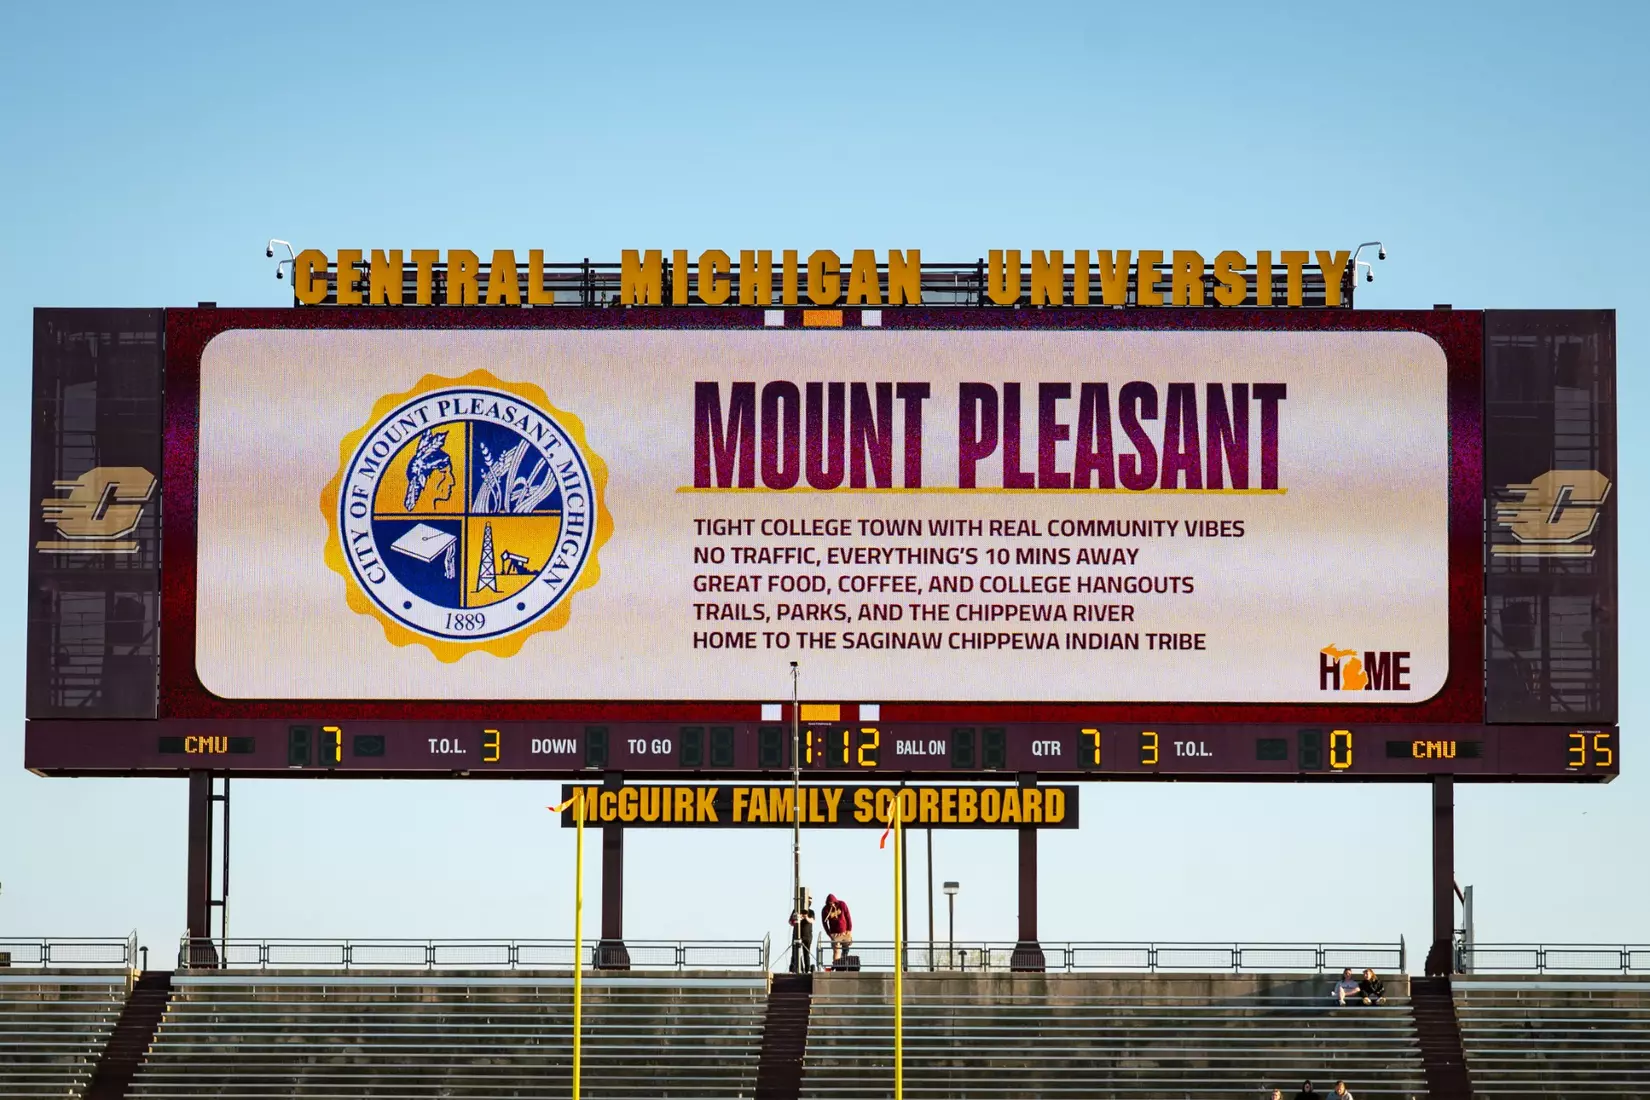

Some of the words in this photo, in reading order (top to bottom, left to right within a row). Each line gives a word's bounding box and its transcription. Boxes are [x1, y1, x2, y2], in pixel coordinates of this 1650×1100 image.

[295, 249, 555, 305] CENTRAL
[620, 249, 922, 305] MICHIGAN
[987, 249, 1351, 307] UNIVERSITY
[358, 405, 431, 482] MOUNT
[436, 397, 562, 459] PLEASANT,
[694, 380, 931, 490] MOUNT
[958, 380, 1287, 491] PLEASANT
[349, 484, 369, 520] OF
[541, 459, 585, 592] MICHIGAN
[693, 518, 756, 537] TIGHT
[760, 518, 852, 537] COLLEGE
[857, 518, 923, 537] TOWN
[928, 519, 983, 537] WITH
[989, 519, 1043, 537] REAL
[1047, 519, 1179, 538] COMMUNITY
[1184, 519, 1246, 538] VIBES
[350, 529, 387, 586] CITY
[694, 546, 725, 565] NO
[730, 546, 821, 567] TRAFFIC,
[827, 547, 978, 566] EVERYTHING'S
[985, 547, 1010, 566] 10
[1016, 547, 1071, 566] MINS
[1076, 547, 1139, 566] AWAY
[693, 574, 763, 593] GREAT
[768, 575, 832, 596] FOOD,
[838, 575, 923, 596] COFFEE,
[928, 575, 974, 594] AND
[979, 575, 1071, 594] COLLEGE
[1077, 576, 1194, 594] HANGOUTS
[443, 612, 486, 632] 1889
[693, 603, 771, 624] TRAILS,
[777, 603, 852, 624] PARKS,
[857, 603, 903, 622] AND
[908, 603, 950, 622] THE
[955, 603, 1068, 622] CHIPPEWA
[1073, 604, 1135, 622] RIVER
[693, 631, 757, 650] HOME
[762, 631, 791, 650] TO
[795, 631, 837, 650] THE
[842, 631, 943, 650] SAGINAW
[948, 632, 1060, 651] CHIPPEWA
[1065, 632, 1139, 651] INDIAN
[1145, 632, 1207, 651] TRIBE
[1320, 651, 1411, 691] HME
[184, 735, 228, 754] CMU
[322, 726, 342, 762] 7
[428, 738, 467, 755] T.O.L.
[483, 729, 500, 762] 3
[531, 738, 578, 755] DOWN
[627, 738, 647, 755] TO
[651, 738, 672, 755] GO
[806, 727, 880, 767] 1:12
[896, 739, 927, 756] BALL
[929, 739, 946, 756] ON
[1031, 740, 1062, 757] QTR
[1081, 728, 1101, 765] 7
[1142, 731, 1159, 764] 3
[1173, 741, 1213, 757] T.O.L.
[1330, 729, 1352, 769] 0
[1412, 740, 1457, 759] CMU
[1568, 733, 1612, 767] 35
[572, 786, 719, 823] McGUIRK
[732, 787, 844, 823] FAMILY
[853, 787, 1066, 824] SCOREBOARD
